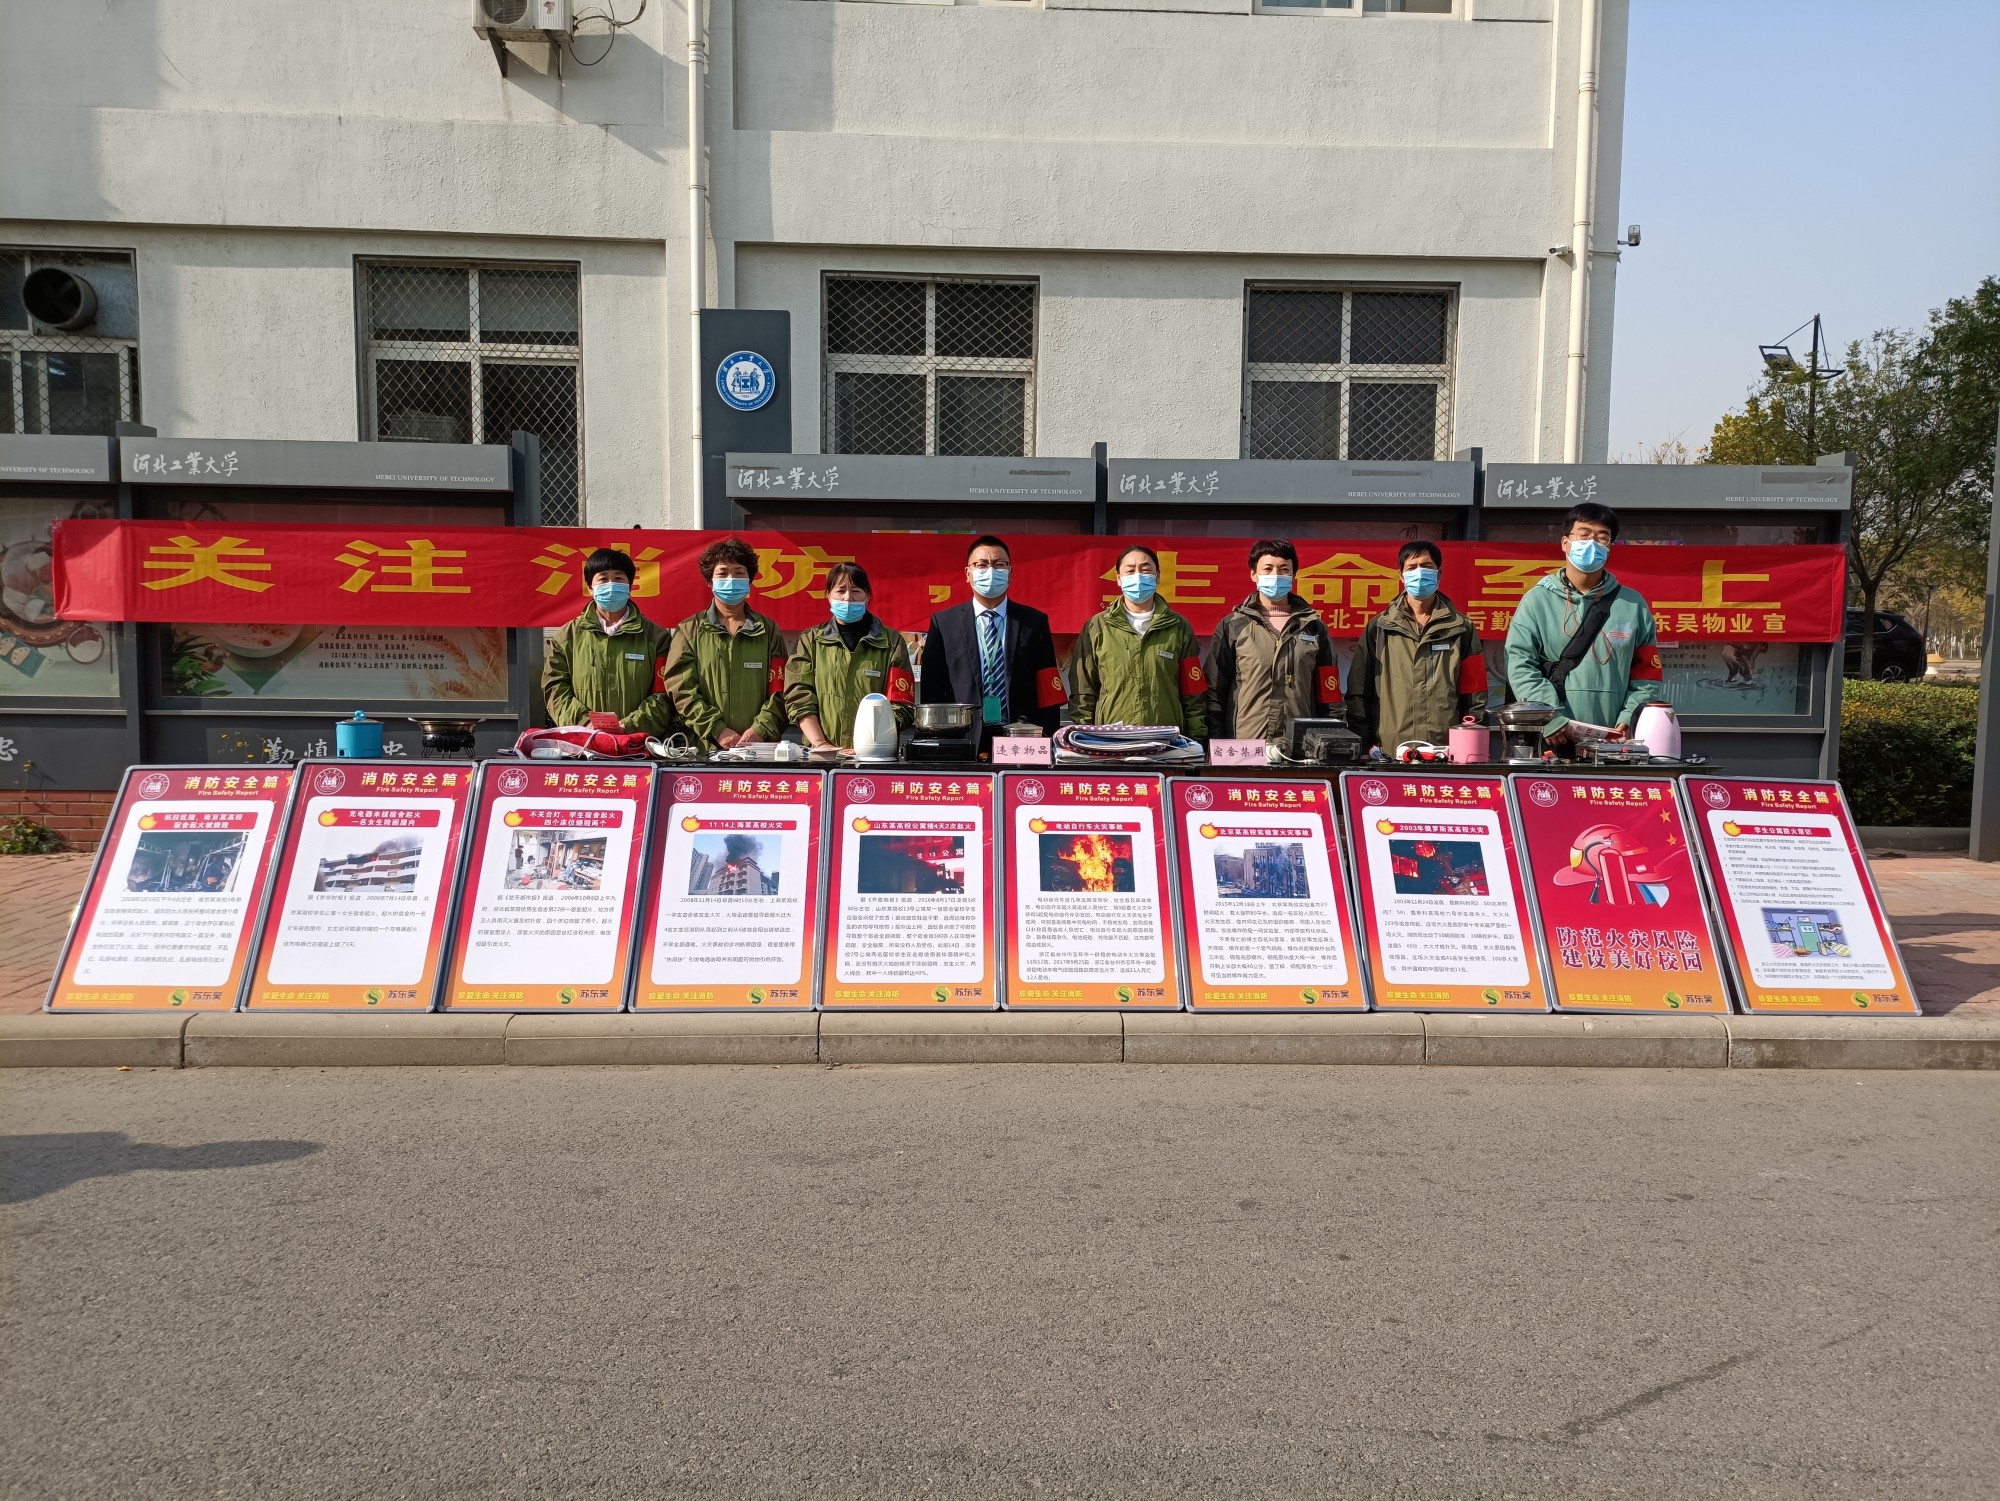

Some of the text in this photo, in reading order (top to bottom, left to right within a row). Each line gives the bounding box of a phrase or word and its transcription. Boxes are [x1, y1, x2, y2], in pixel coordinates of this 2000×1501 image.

[1653, 612, 1753, 634] 东吴物业
[1763, 613, 1786, 633] 宣
[996, 745, 1048, 756] 违章物品
[1213, 745, 1265, 757] 宿舍禁用
[184, 775, 279, 789] 消防安全篇
[362, 772, 458, 786] 消防安全篇
[544, 773, 637, 787] 消防安全篇
[718, 780, 809, 793] 消防安全篇
[891, 782, 980, 795] 消防安全篇
[1060, 783, 1148, 795] 消防安全篇
[1403, 784, 1491, 798] 消防安全篇
[1228, 789, 1316, 802] 消防安全篇
[1573, 786, 1662, 800] 消防安全篇
[1743, 788, 1829, 804] 消防安全篇
[1761, 802, 1816, 810] Fire Safety Report
[349, 810, 421, 818] 充电器未拔宿舍起火
[544, 819, 607, 827] 四个床位烧毁两个
[874, 822, 972, 830] 山东某高校公寓楼4天2次起火
[1056, 823, 1123, 831] 电动自行车火灾事故
[1220, 829, 1309, 837] 北京某高校实验室火灾事故
[1400, 825, 1484, 833] 2003年俄罗斯某高校火灾
[1754, 827, 1812, 835] 学生公寓防火常识
[1556, 927, 1698, 951] 防范火灾风险
[1562, 947, 1703, 972] 建设美好校园
[66, 993, 134, 1001] 珍爱生命 关注消防
[263, 992, 329, 1000] 珍爱生命 关注消防
[649, 992, 714, 1000] 珍爱生命 关注消防
[1019, 990, 1083, 998] 珍爱生命 关注消防
[1205, 992, 1268, 1000] 珍爱生命 关注消防
[1569, 993, 1632, 1002] 珍爱生命 关注消防
[1759, 995, 1821, 1003] 珍爱生命 关注消防
